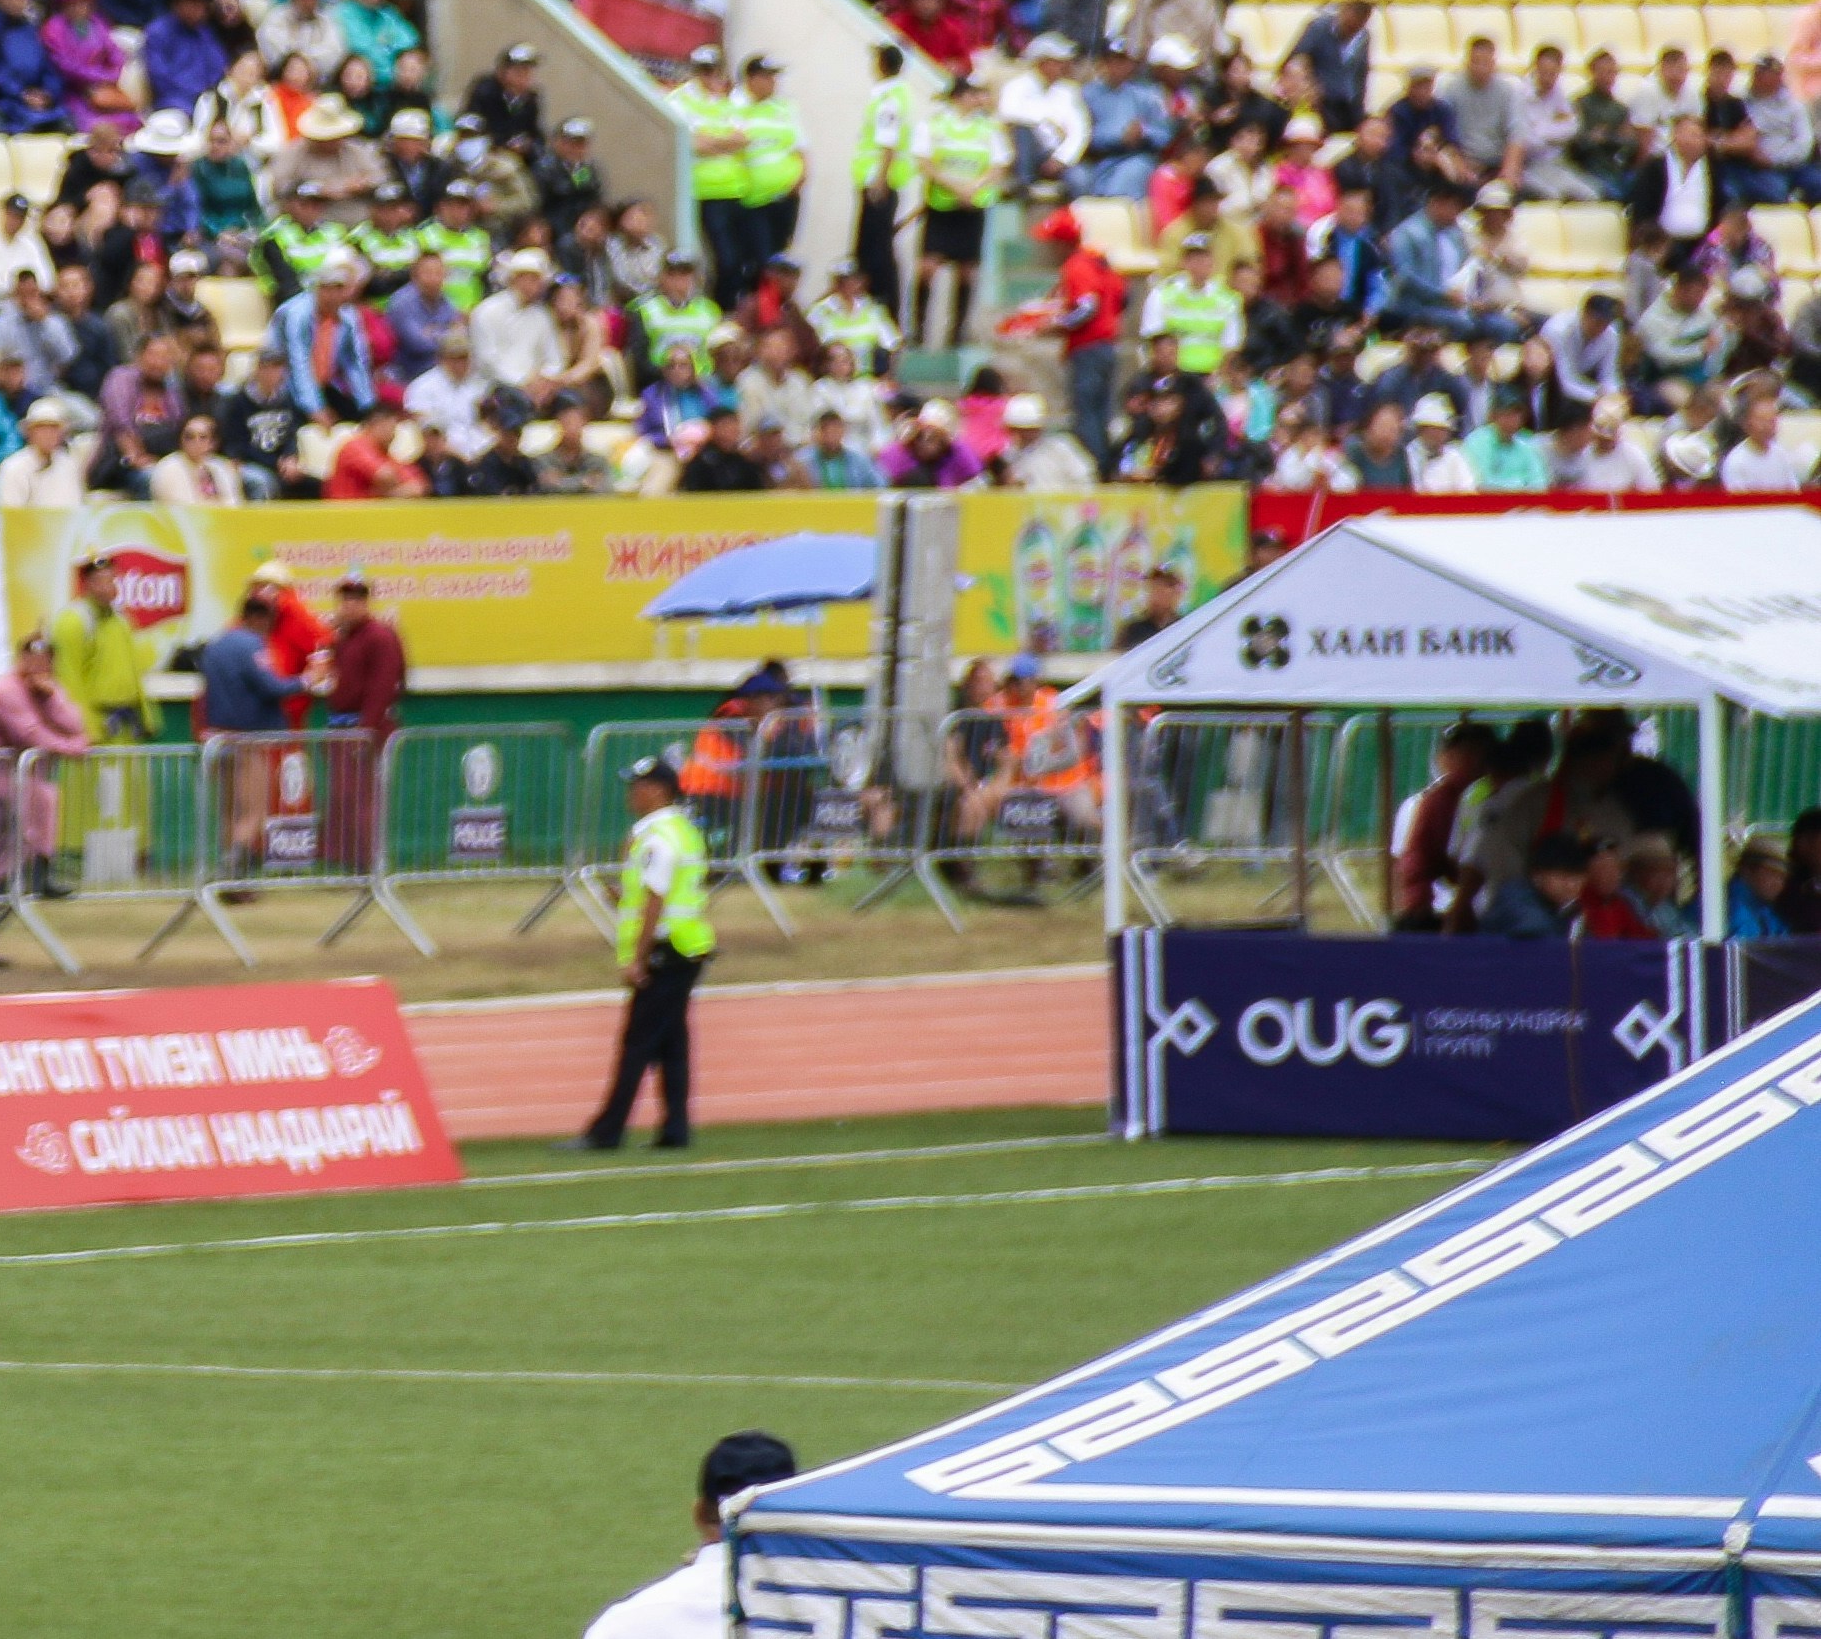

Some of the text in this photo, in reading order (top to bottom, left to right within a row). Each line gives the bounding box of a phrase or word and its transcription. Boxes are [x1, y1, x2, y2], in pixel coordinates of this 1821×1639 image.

[1309, 627, 1407, 656] ХААН
[95, 1032, 225, 1091] ТҮМЭН
[216, 1026, 331, 1084] МИНЬ
[1238, 998, 1410, 1066] OUG
[69, 1105, 217, 1174] САЙХАН
